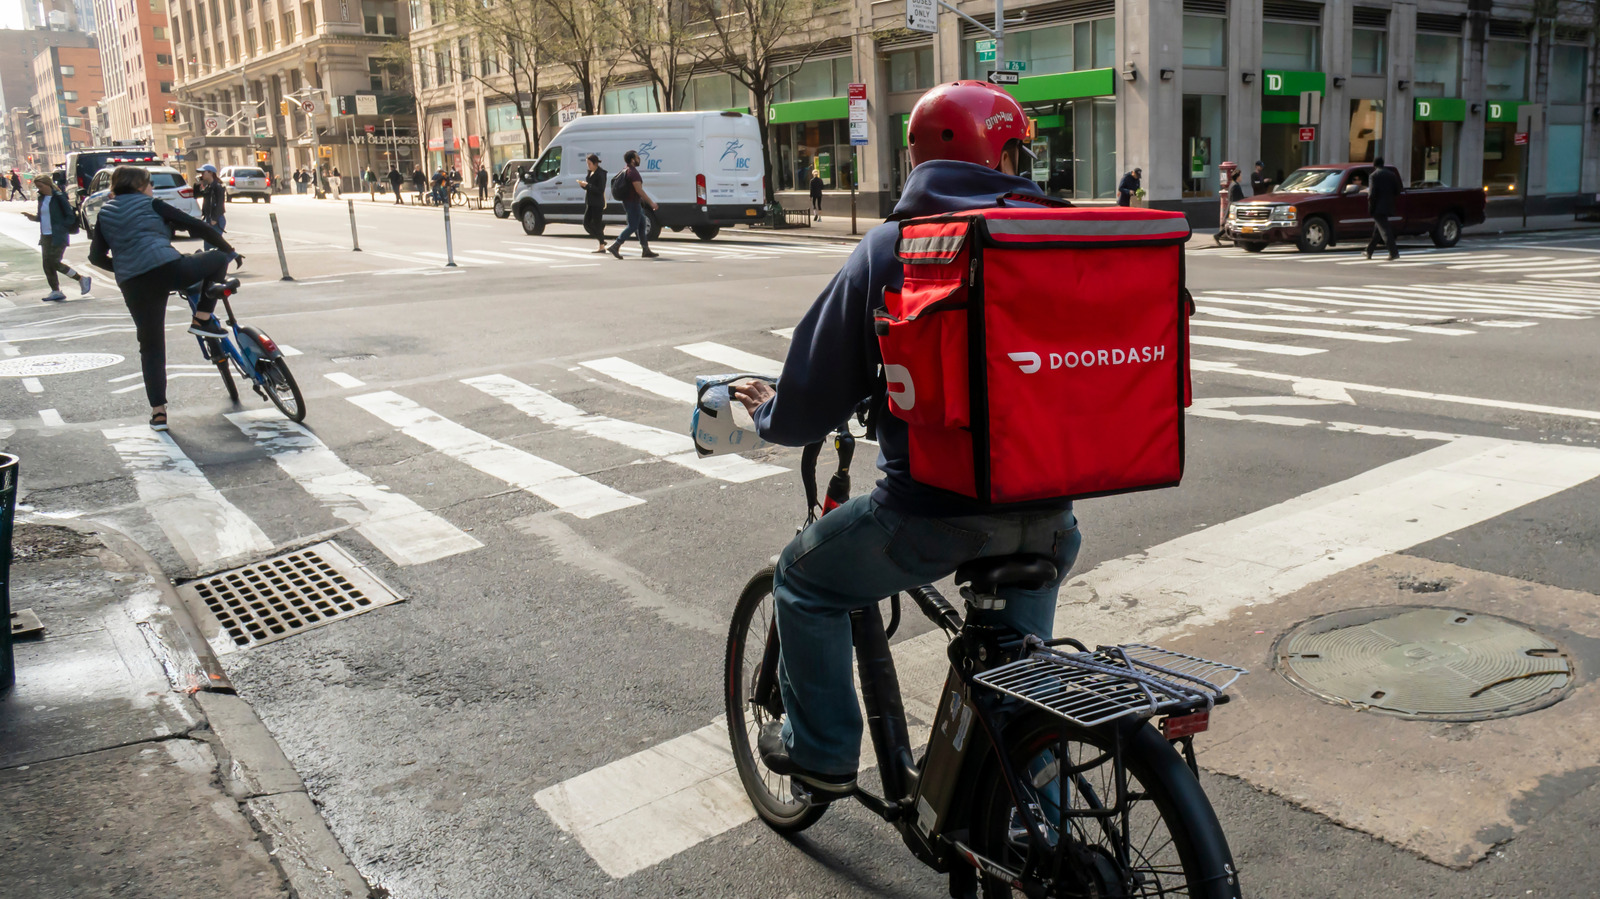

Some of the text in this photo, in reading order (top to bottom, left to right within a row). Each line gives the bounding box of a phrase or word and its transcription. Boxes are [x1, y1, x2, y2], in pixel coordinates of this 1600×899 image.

[914, 9, 930, 18] ONLY
[1011, 62, 1020, 70] 26
[1267, 74, 1282, 91] TD
[1418, 102, 1430, 117] TD
[1490, 104, 1501, 118] TD
[647, 159, 662, 170] IBC
[736, 157, 750, 168] IBC
[1050, 345, 1165, 370] DOORDASH
